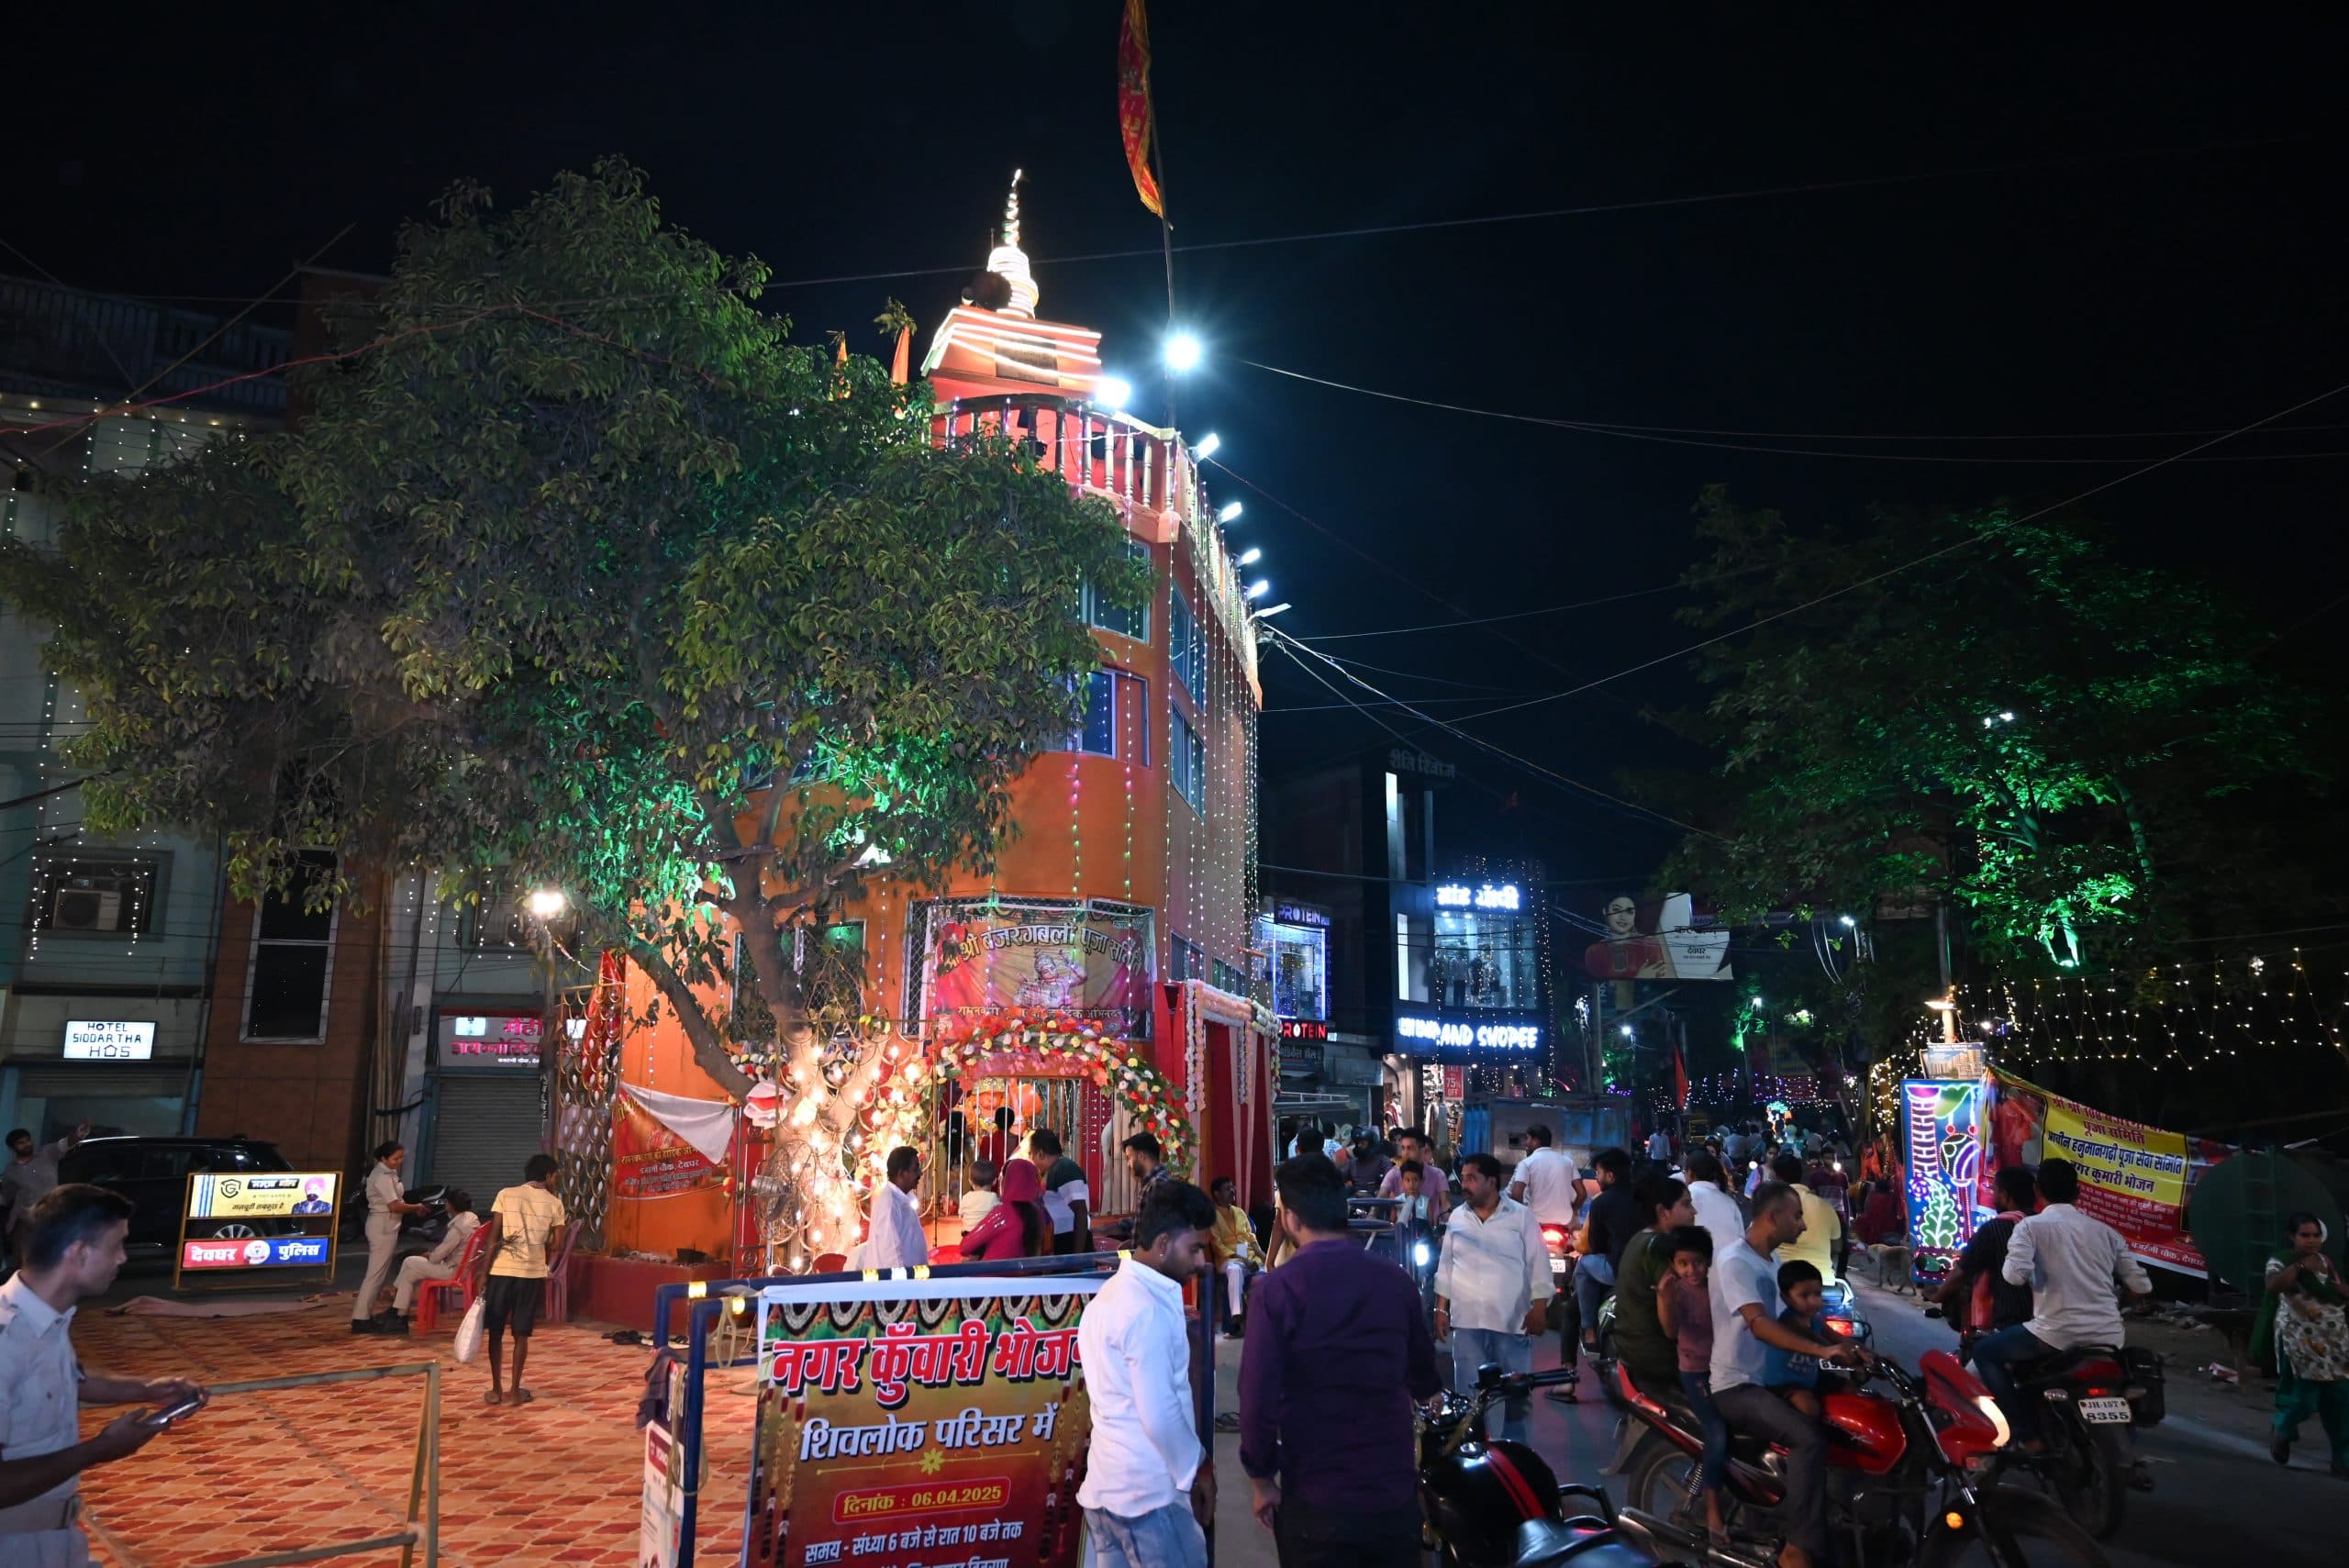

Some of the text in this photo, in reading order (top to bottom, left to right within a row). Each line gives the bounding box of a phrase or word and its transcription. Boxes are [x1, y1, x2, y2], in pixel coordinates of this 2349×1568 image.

[1278, 905, 1320, 924] PROTEIN
[1080, 926, 1110, 955] पूजा
[72, 1033, 141, 1043] SIDDARTHA
[87, 1022, 128, 1032] HOTEL
[2083, 1120, 2106, 1137] पूजा
[2109, 1127, 2145, 1145] समिति
[2047, 1130, 2071, 1150] प्राचीन
[2119, 1150, 2136, 1169] पूजा
[2136, 1149, 2154, 1169] सेवा
[2154, 1152, 2184, 1175] समिति
[2092, 1167, 2123, 1184] कुमारी
[2125, 1173, 2155, 1193] भोजन
[191, 1242, 321, 1262] देवघर पुलिस
[771, 1338, 868, 1393] नगर
[2086, 1412, 2130, 1421] 8355
[799, 1402, 1060, 1462] शिवलोक परिसर में
[842, 1493, 896, 1515] दिनांक
[911, 1485, 1002, 1507] 06.04.2025
[805, 1539, 843, 1564] समय
[852, 1530, 885, 1557] संध्या
[888, 1533, 897, 1551] 6
[900, 1526, 920, 1550] बजे
[923, 1525, 937, 1549] से
[939, 1523, 960, 1546] रात
[962, 1524, 977, 1544] 10
[979, 1518, 1001, 1541] बजे
[1001, 1520, 1025, 1540] तक
